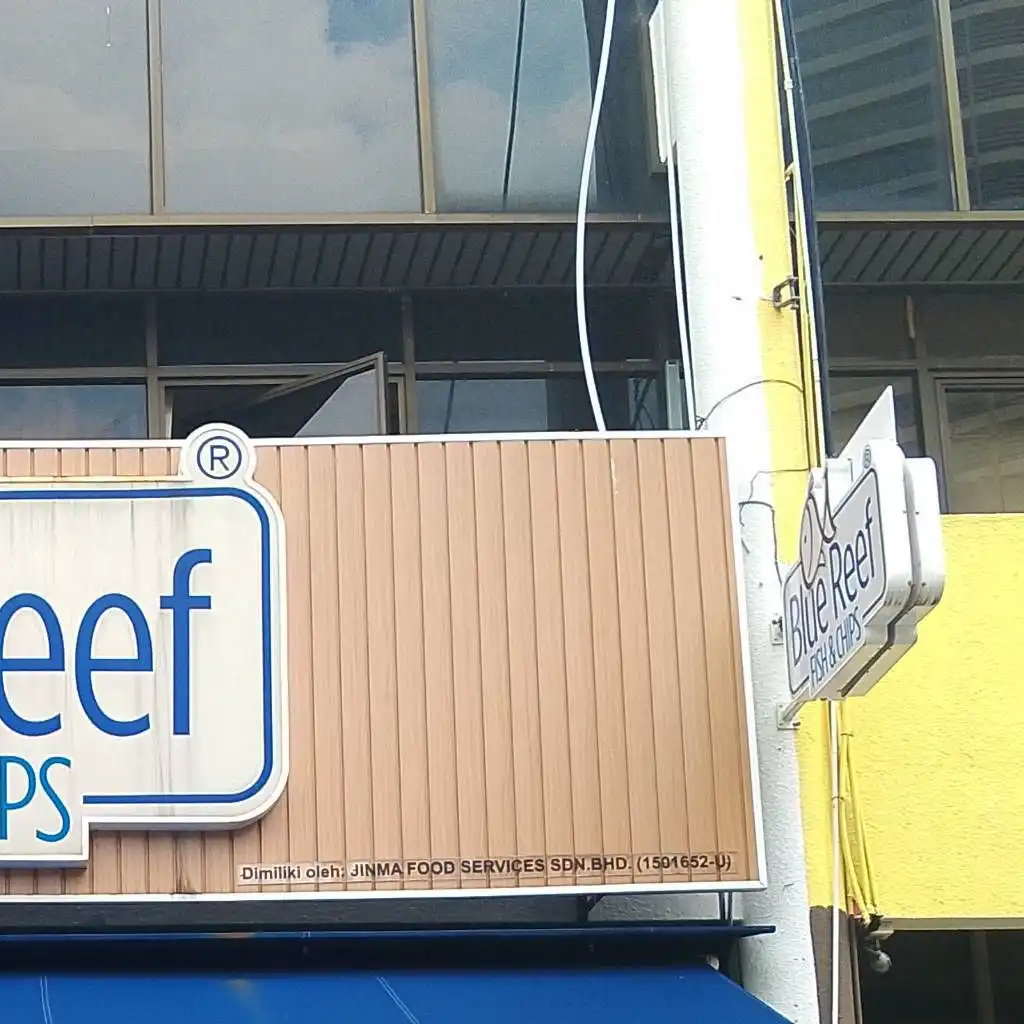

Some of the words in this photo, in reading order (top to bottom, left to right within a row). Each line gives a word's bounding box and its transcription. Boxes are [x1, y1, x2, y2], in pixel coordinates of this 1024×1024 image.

[789, 576, 828, 667] Blue
[829, 496, 875, 620] Reef
[810, 642, 829, 689] FISH
[836, 605, 861, 659] CHIPS
[241, 864, 301, 880] Dimiliki
[306, 864, 344, 879] oleh:
[350, 862, 403, 877] JINMA
[407, 860, 456, 876] FOOD
[460, 858, 545, 874] SERVICES
